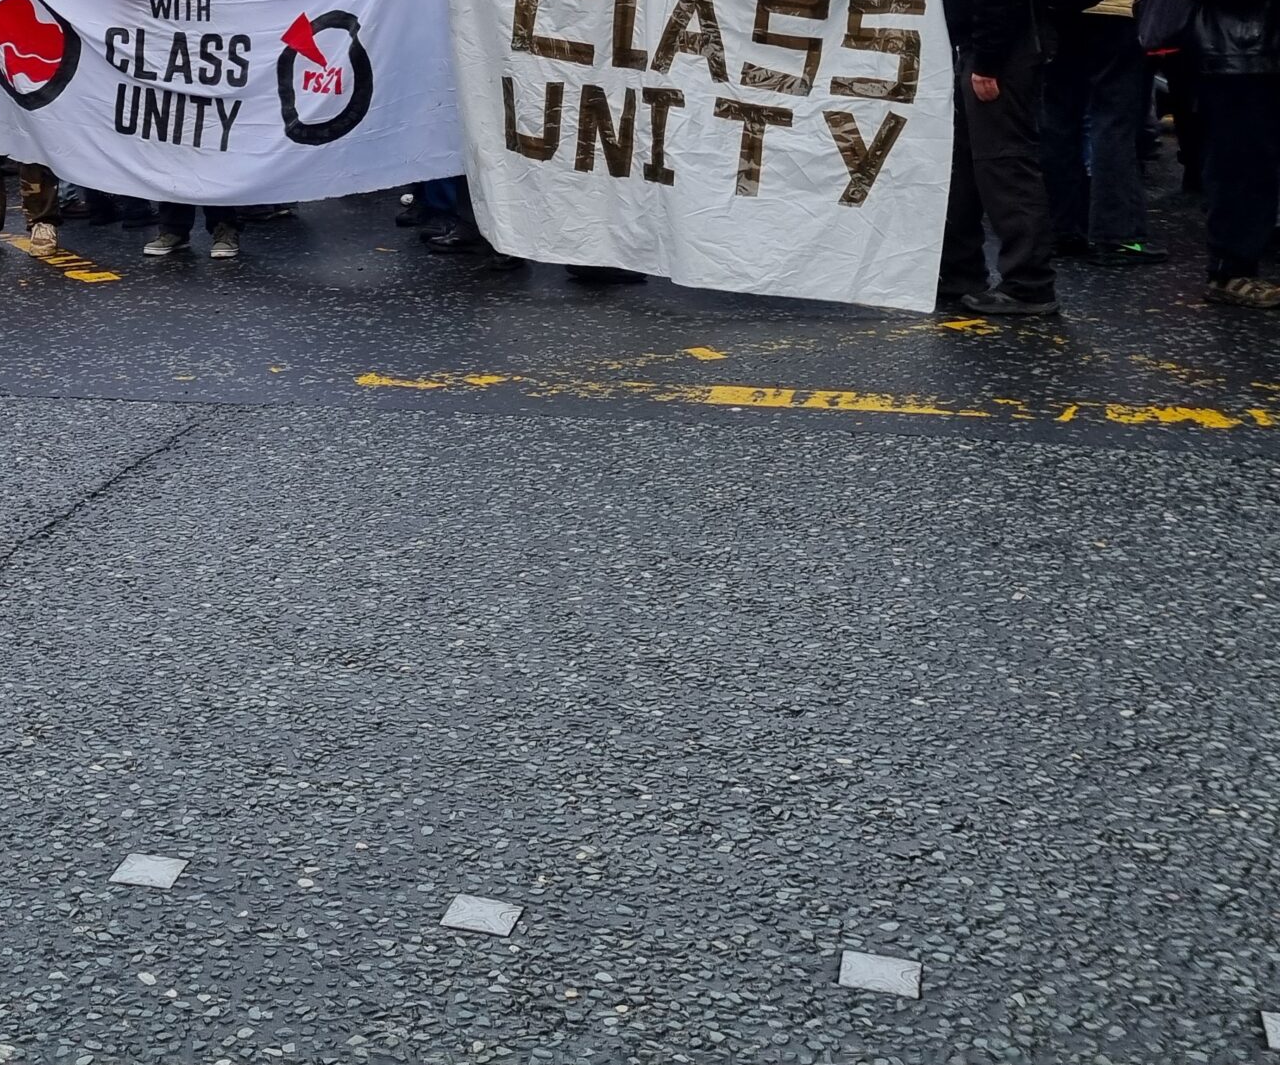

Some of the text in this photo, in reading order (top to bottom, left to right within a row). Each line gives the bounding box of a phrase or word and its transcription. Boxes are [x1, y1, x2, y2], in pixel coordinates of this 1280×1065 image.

[105, 27, 252, 88] CLASS
[302, 67, 342, 95] rs21
[115, 83, 243, 152] UNITY
[502, 76, 908, 207] UNITY
